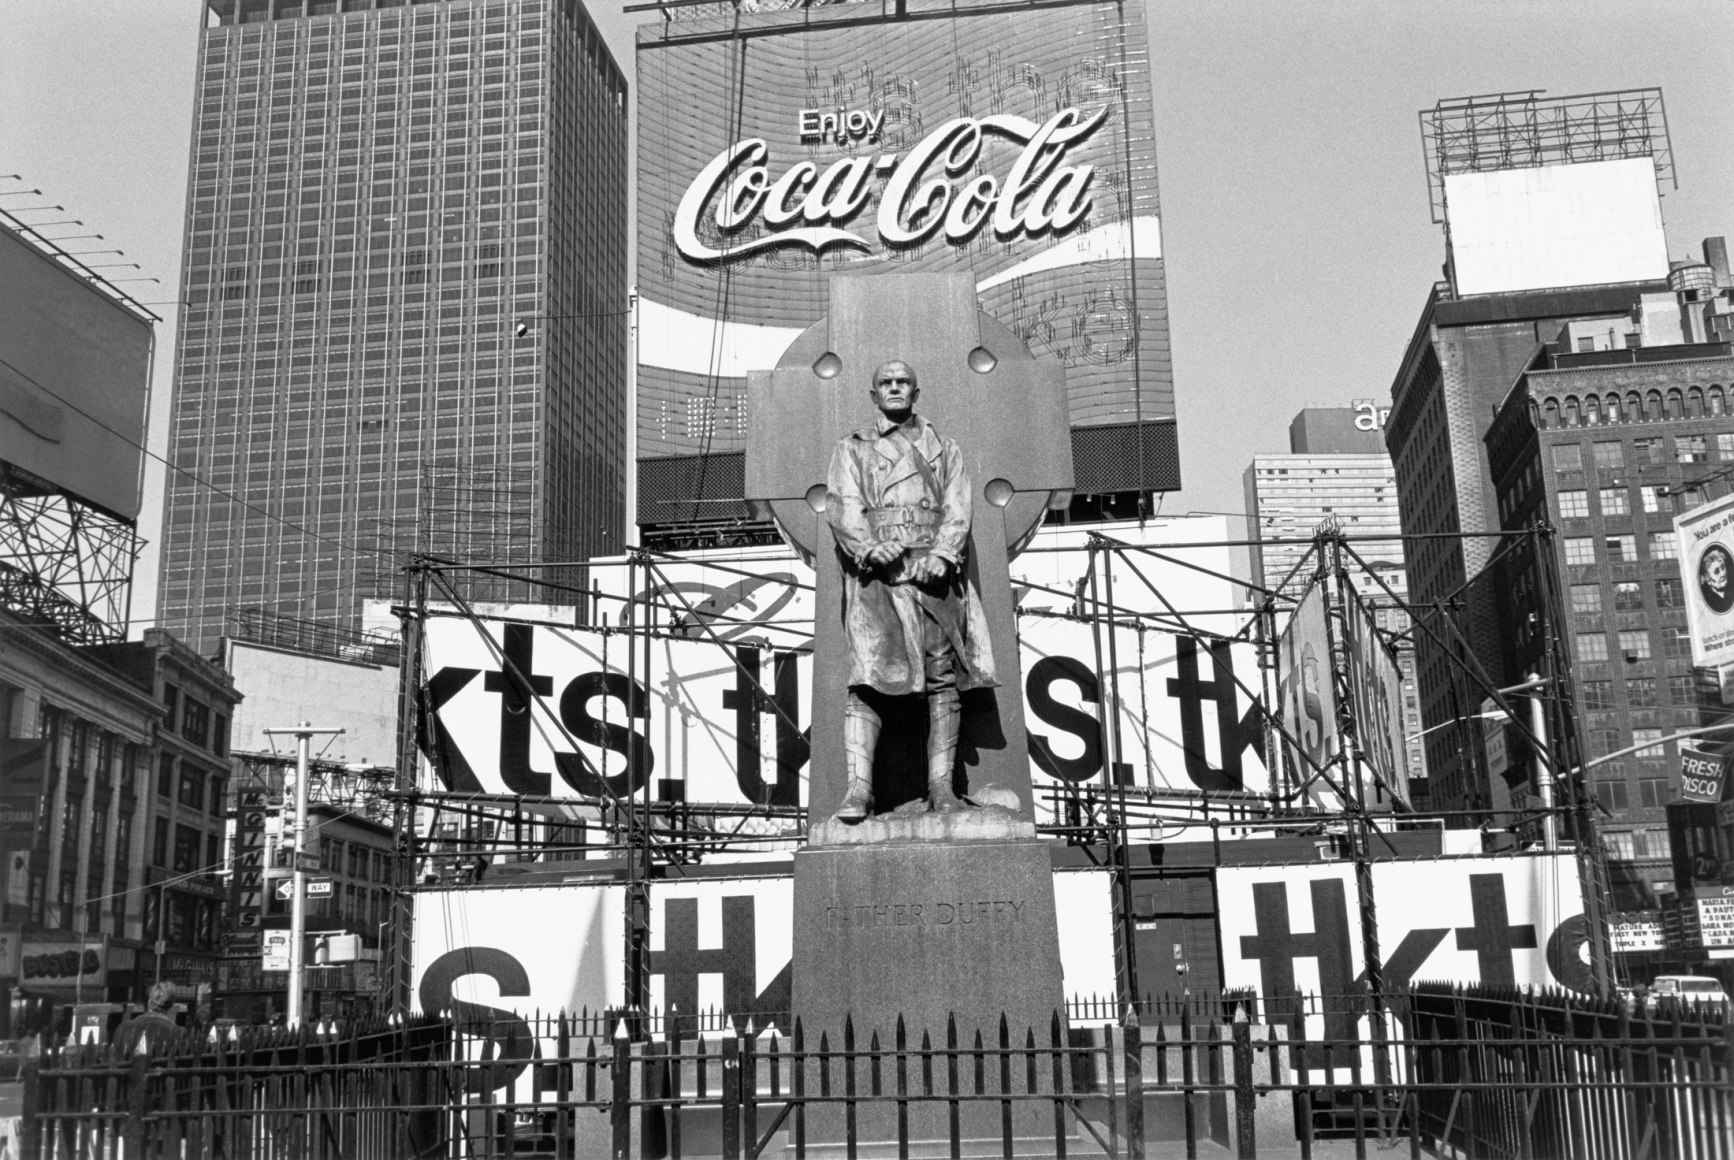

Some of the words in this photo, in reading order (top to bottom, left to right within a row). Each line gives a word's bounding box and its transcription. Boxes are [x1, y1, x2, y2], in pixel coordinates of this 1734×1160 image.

[799, 108, 885, 141] Enjoy
[674, 104, 1108, 260] Coca-Cola
[1693, 529, 1709, 541] You
[1710, 522, 1722, 534] are
[1682, 756, 1724, 778] FRESH
[1682, 774, 1717, 796] DISCO
[826, 903, 927, 929] FATHER
[937, 900, 1027, 926] DUFFY
[1614, 924, 1643, 932] MATURE
